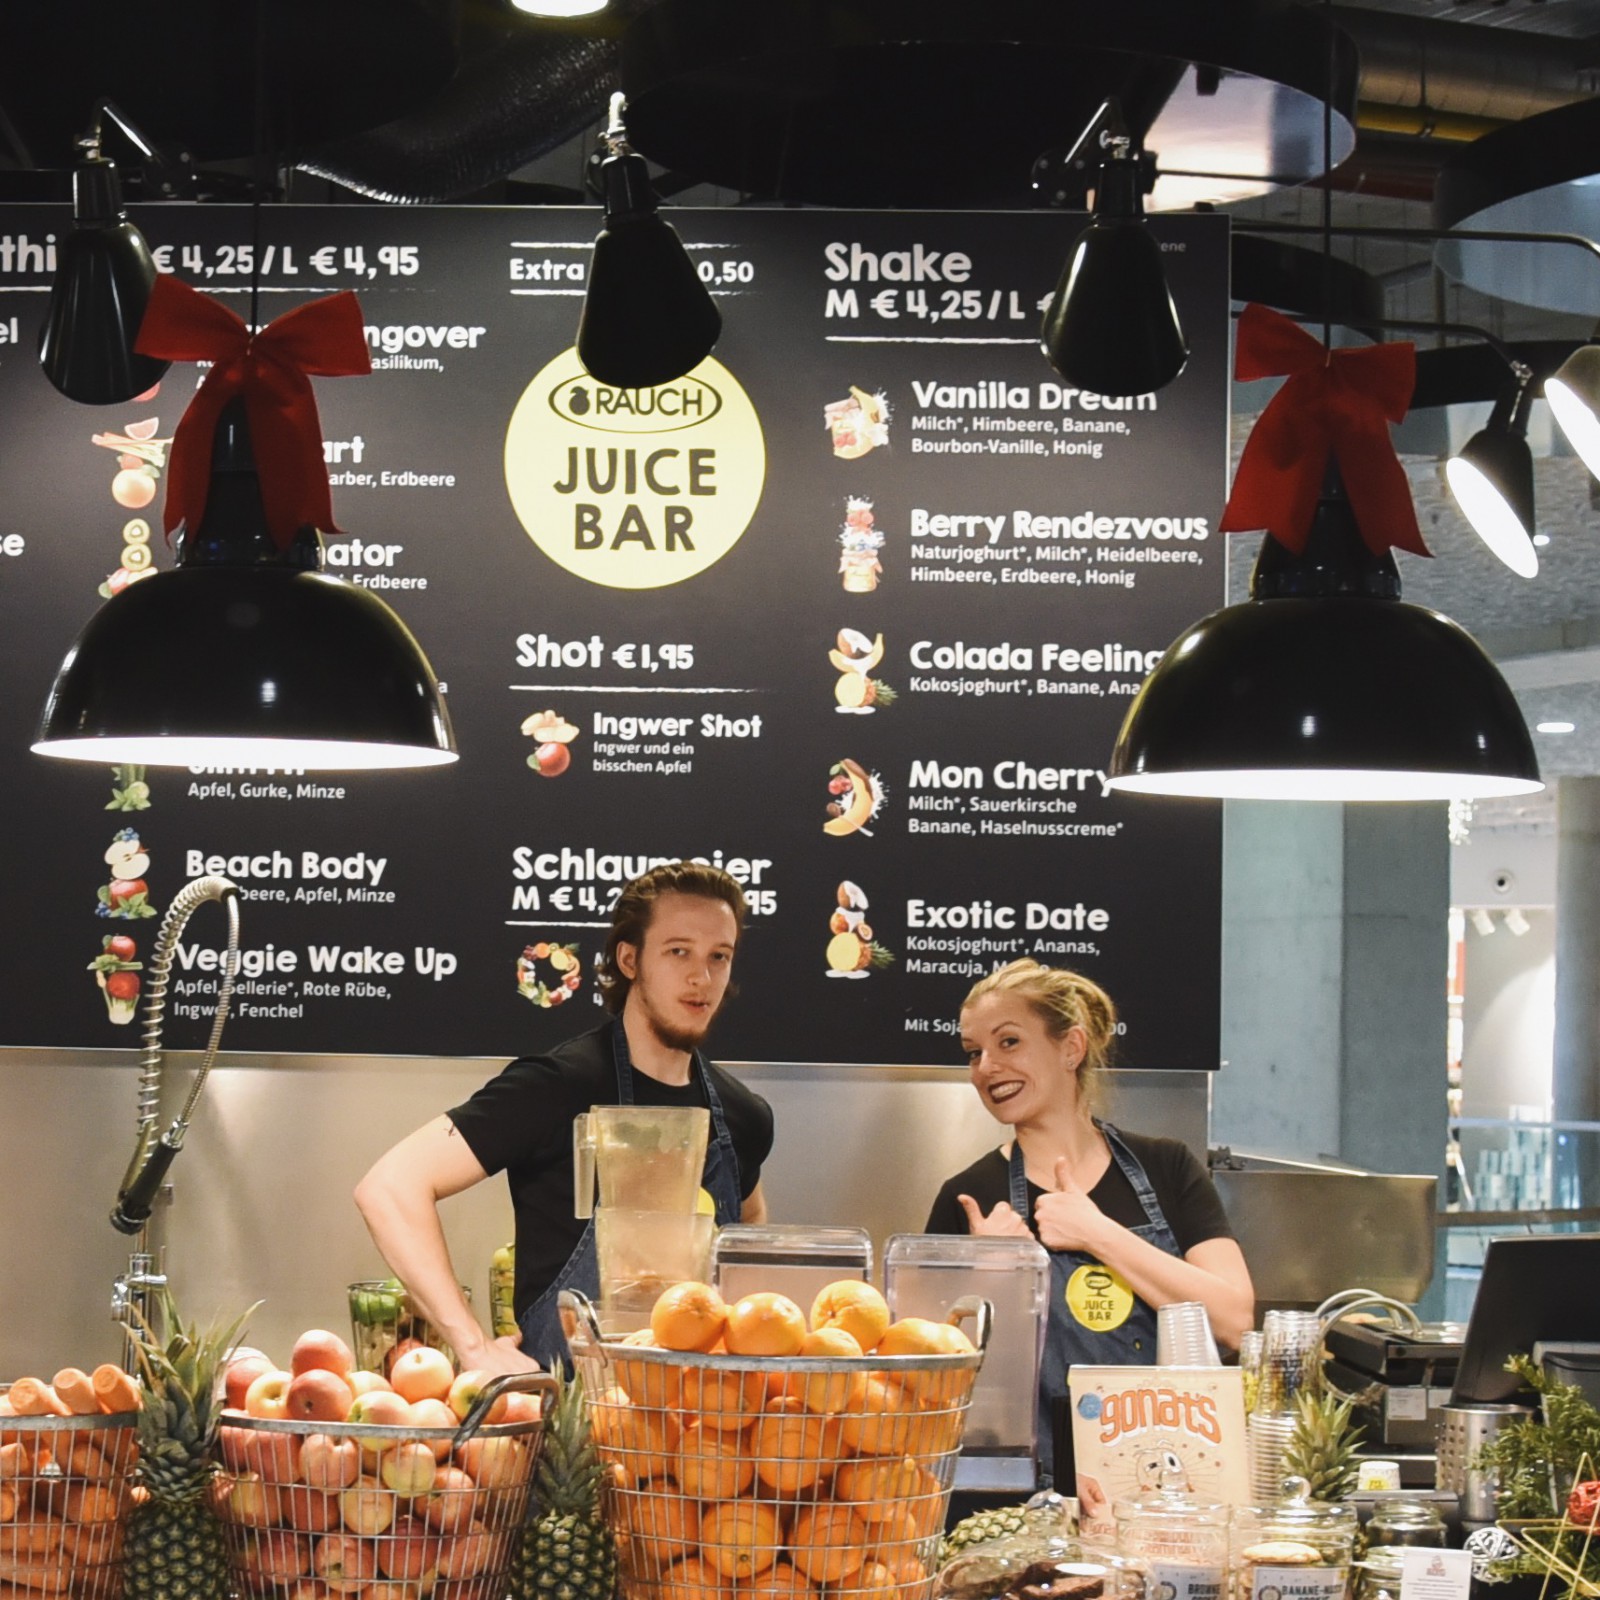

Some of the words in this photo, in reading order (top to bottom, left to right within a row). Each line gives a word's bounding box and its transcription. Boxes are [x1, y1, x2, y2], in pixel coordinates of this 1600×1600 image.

[510, 258, 585, 281] Extra
[825, 243, 971, 282] Shake
[825, 289, 859, 318] M
[363, 324, 487, 355] ngover
[372, 354, 444, 372] asilikum,
[596, 386, 703, 417] RAUCH
[912, 381, 1029, 409] Vanilla
[973, 417, 1058, 434] Himbeere,
[1063, 418, 1130, 435] Banane,
[912, 438, 1049, 456] Bourbon-Vanille,
[1054, 440, 1102, 458] Honig
[381, 471, 455, 486] Erdbeere
[553, 447, 717, 496] JUICE
[574, 504, 696, 552] BAR
[911, 509, 1006, 544] Berry
[1013, 511, 1208, 540] Rendezvous
[1097, 547, 1202, 564] Heidelbeere,
[911, 567, 997, 584] Himbeere,
[1001, 568, 1081, 586] Erdbeere,
[1086, 570, 1135, 588] Honig
[516, 634, 604, 667] Shot
[910, 641, 1032, 670] Colada
[1037, 679, 1104, 696] Banane,
[594, 712, 693, 740] Ingwer
[701, 714, 762, 737] Shot
[594, 741, 641, 756] Ingwer
[644, 742, 670, 754] und
[673, 743, 694, 754] ein
[593, 759, 652, 772] bisschen
[656, 761, 691, 775] Apfel
[909, 761, 983, 788] Mon
[993, 760, 1112, 796] Cherry
[188, 782, 235, 799] Apfel,
[240, 783, 292, 800] Gurke,
[297, 784, 345, 799] Minze
[970, 797, 1077, 813] Sauerkirsche
[909, 818, 976, 836] Banane,
[185, 850, 293, 879] Beach
[302, 852, 387, 886] Body
[295, 887, 342, 904] Apfel,
[347, 888, 395, 902] Minze
[907, 900, 1015, 929] Exotic
[1026, 903, 1109, 931] Date
[1034, 939, 1100, 955] Ananas,
[175, 943, 297, 979] Veggie
[308, 946, 405, 974] Wake
[415, 947, 457, 981] Up
[906, 958, 988, 976] Maracuja,
[304, 982, 340, 996] Rote
[345, 982, 391, 999] Rübe,
[240, 1003, 303, 1018] Fenchel
[905, 1019, 928, 1031] Mit
[1082, 1300, 1115, 1310] JUICE
[1087, 1311, 1112, 1321] BAR
